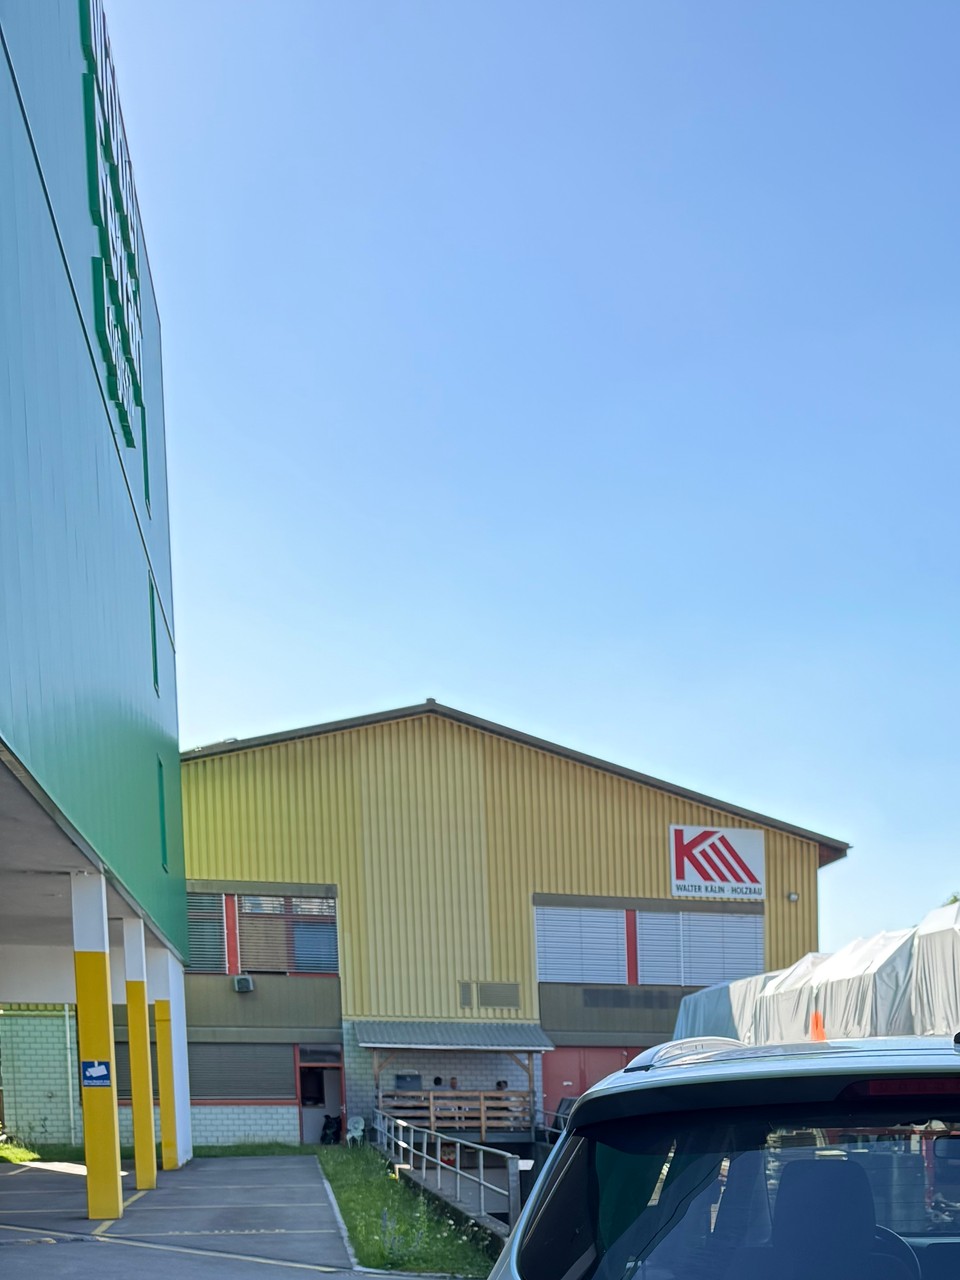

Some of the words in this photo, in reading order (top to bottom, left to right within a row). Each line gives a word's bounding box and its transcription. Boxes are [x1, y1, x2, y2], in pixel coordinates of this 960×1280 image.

[676, 884, 702, 893] WALTER
[705, 884, 725, 894] KÄLIN
[731, 887, 763, 896] HOLZBAU
